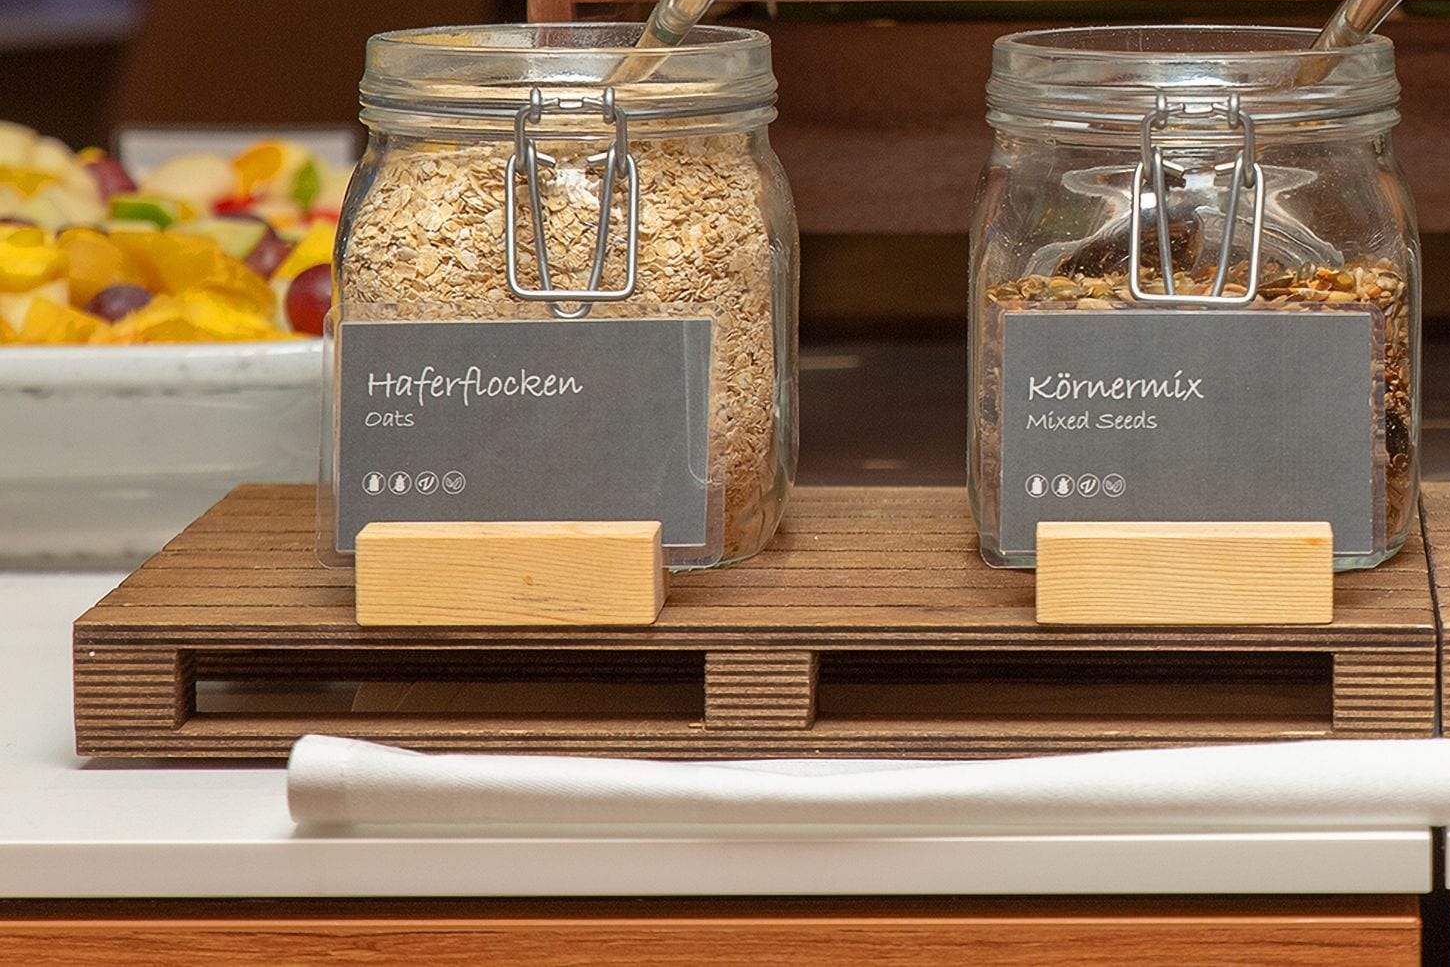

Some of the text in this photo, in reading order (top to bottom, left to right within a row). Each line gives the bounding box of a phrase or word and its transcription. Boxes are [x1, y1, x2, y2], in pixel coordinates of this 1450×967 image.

[367, 366, 583, 406] Haferflocken
[1028, 370, 1205, 401] Körnermix
[364, 411, 415, 427] Oats
[1026, 411, 1158, 431] Mixed Seeds
